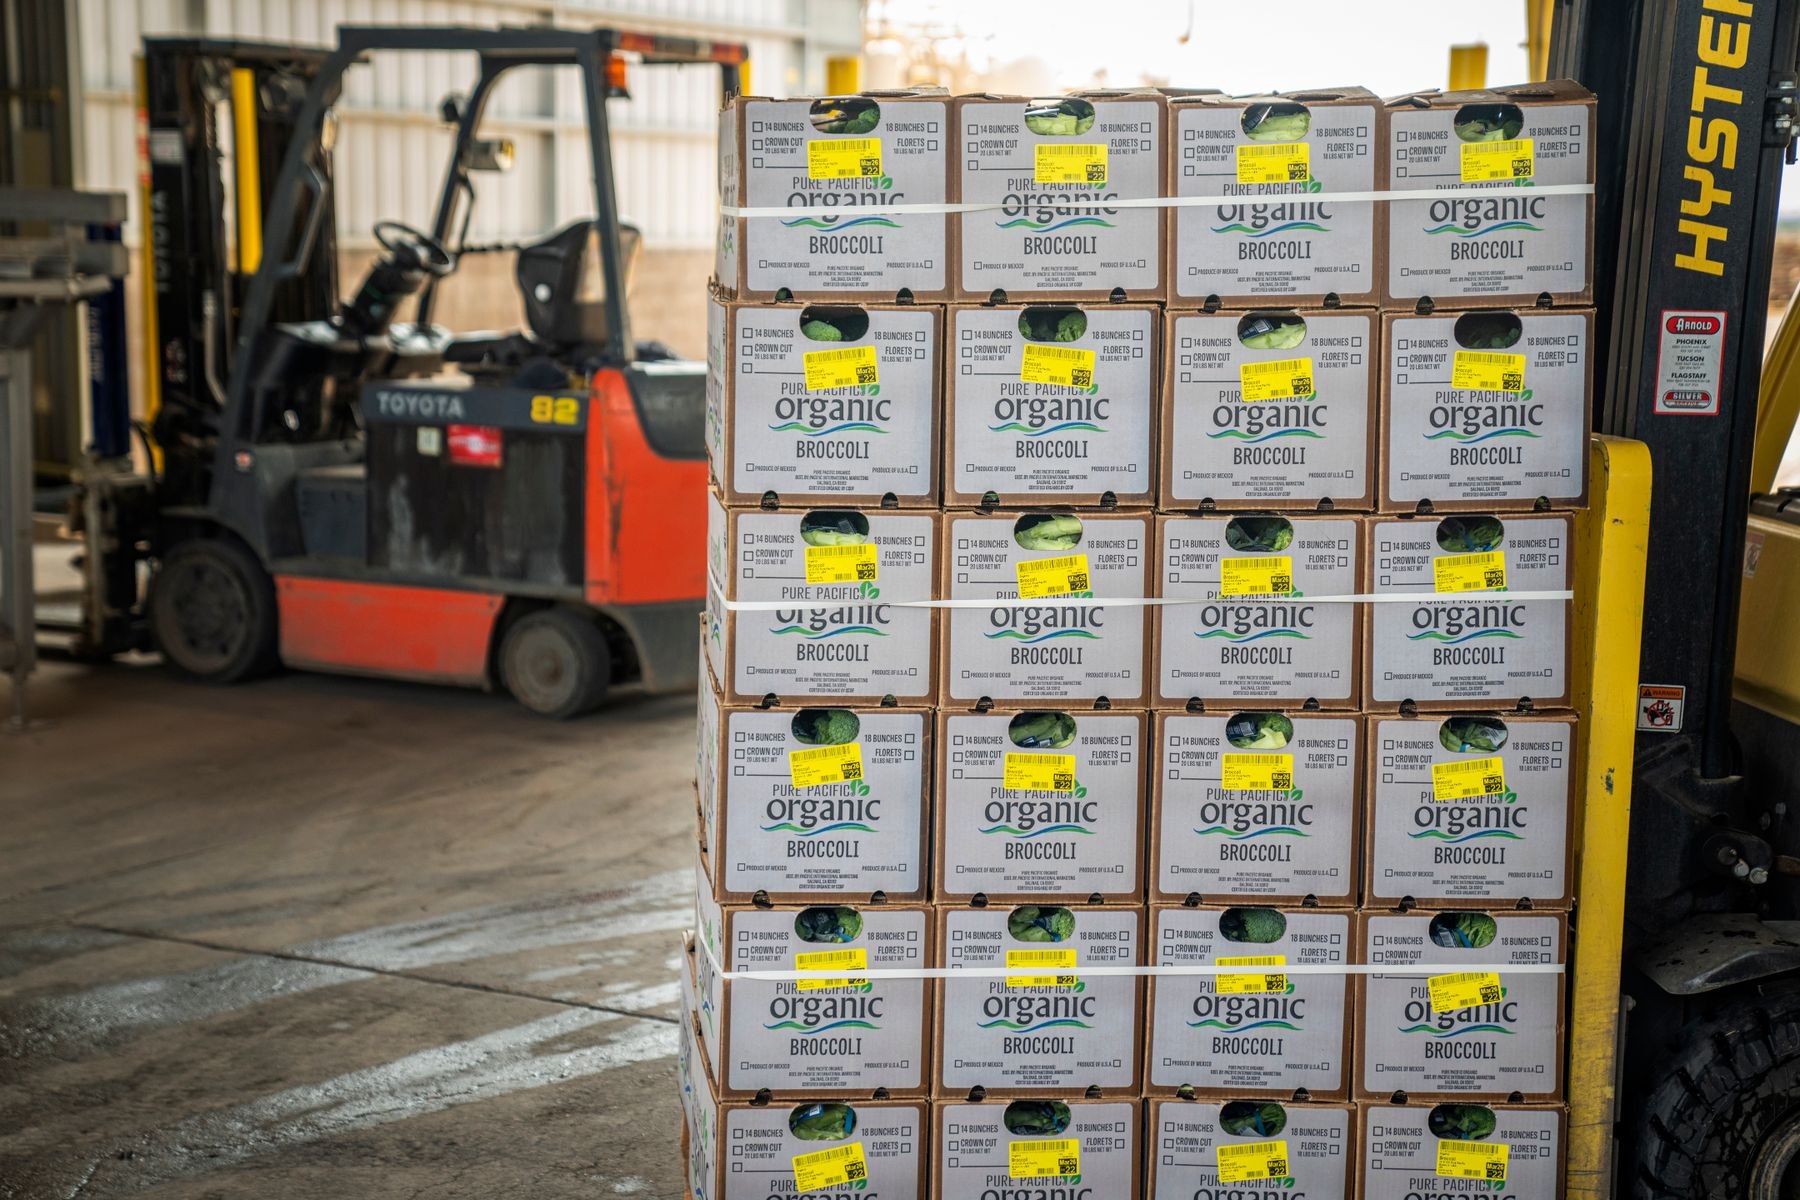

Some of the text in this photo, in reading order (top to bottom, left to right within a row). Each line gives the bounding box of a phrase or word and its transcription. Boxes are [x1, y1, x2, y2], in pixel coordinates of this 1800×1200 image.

[764, 122, 804, 131] 14 BUNCHES
[885, 122, 924, 132] 18 BUNCHES
[1315, 127, 1354, 137] 18 BUNCHES
[1196, 129, 1235, 139] 14 BUNCHES
[979, 139, 1018, 148] CROWN CUT
[1110, 138, 1138, 147] FLORETS
[1539, 141, 1567, 151] FLORETS
[1408, 145, 1446, 155] CROWN CUT
[1429, 196, 1545, 229] organic
[809, 235, 883, 254] BROCCOLI
[1023, 235, 1097, 255] BROCCOLI
[1238, 240, 1311, 260] BROCCOLI
[1451, 239, 1523, 260] BROCCOLI
[1676, 318, 1712, 331] ARNOLD
[973, 330, 1012, 339] 14 BUNCHES
[1092, 330, 1130, 339] 18 BUNCHES
[1527, 336, 1565, 346] 18 BUNCHES
[754, 343, 792, 352] CROWN CUT
[1409, 338, 1448, 348] 14 BUNCHES
[885, 346, 912, 355] FLORETS
[1192, 352, 1230, 361] CROWN CUT
[1321, 352, 1348, 361] FLORETS
[1000, 382, 1029, 395] PURE
[1435, 390, 1464, 404] PURE
[1673, 392, 1702, 400] SILVER
[377, 392, 463, 418] TOYOTA
[530, 395, 580, 425] 82
[775, 397, 891, 427] organic
[994, 397, 1109, 427] organic
[1213, 404, 1327, 434] organic
[1429, 403, 1543, 435] organic
[796, 440, 869, 458] BROCCOLI
[1015, 439, 1088, 458] BROCCOLI
[1233, 446, 1305, 465] BROCCOLI
[1450, 446, 1522, 465] BROCCOLI
[755, 534, 794, 543] 14 BUNCHES
[874, 536, 912, 545] 18 BUNCHES
[1181, 539, 1219, 548] 14 BUNCHES
[1298, 540, 1335, 549] 18 BUNCHES
[1392, 555, 1429, 564] CROWN CUT
[1519, 553, 1546, 562] FLORETS
[781, 586, 859, 600] PURE PACIFIC
[990, 605, 1103, 635] organic
[1200, 605, 1314, 634] organic
[1412, 604, 1526, 636] organic
[796, 643, 869, 661] BROCCOLI
[1011, 646, 1082, 665] BROCCOLI
[1221, 646, 1292, 664] BROCCOLI
[1433, 646, 1504, 665] BROCCOLI
[964, 735, 1003, 744] 14 BUNCHES
[1081, 736, 1118, 744] 18 BUNCHES
[1395, 740, 1433, 749] 14 BUNCHES
[1512, 741, 1549, 750] 18 BUNCHES
[746, 746, 784, 755] CROWN CUT
[875, 748, 901, 756] FLORETS
[766, 798, 880, 828] organic
[984, 800, 1097, 830] organic
[1200, 802, 1313, 831] organic
[1414, 805, 1527, 834] organic
[787, 839, 859, 858] BROCCOLI
[1005, 841, 1076, 860] BROCCOLI
[1220, 843, 1291, 861] BROCCOLI
[1434, 846, 1505, 864] BROCCOLI
[750, 931, 788, 940] 14 BUNCHES
[867, 931, 904, 940] 18 BUNCHES
[963, 944, 1000, 953] CROWN CUT
[1090, 945, 1116, 954] FLORETS
[769, 996, 883, 1026] organic
[983, 995, 1095, 1024] organic
[1192, 996, 1305, 1025] organic
[790, 1037, 861, 1055] BROCCOLI
[1003, 1036, 1074, 1054] BROCCOLI
[1212, 1036, 1283, 1055] BROCCOLI
[1424, 1041, 1496, 1059] BROCCOLI
[960, 1124, 998, 1133] 14 BUNCHES
[1075, 1123, 1112, 1132] 18 BUNCHES
[1175, 1137, 1212, 1146] CROWN CUT
[1301, 1141, 1327, 1150] FLORETS
[1409, 1178, 1485, 1191] PURE PACIFIC
